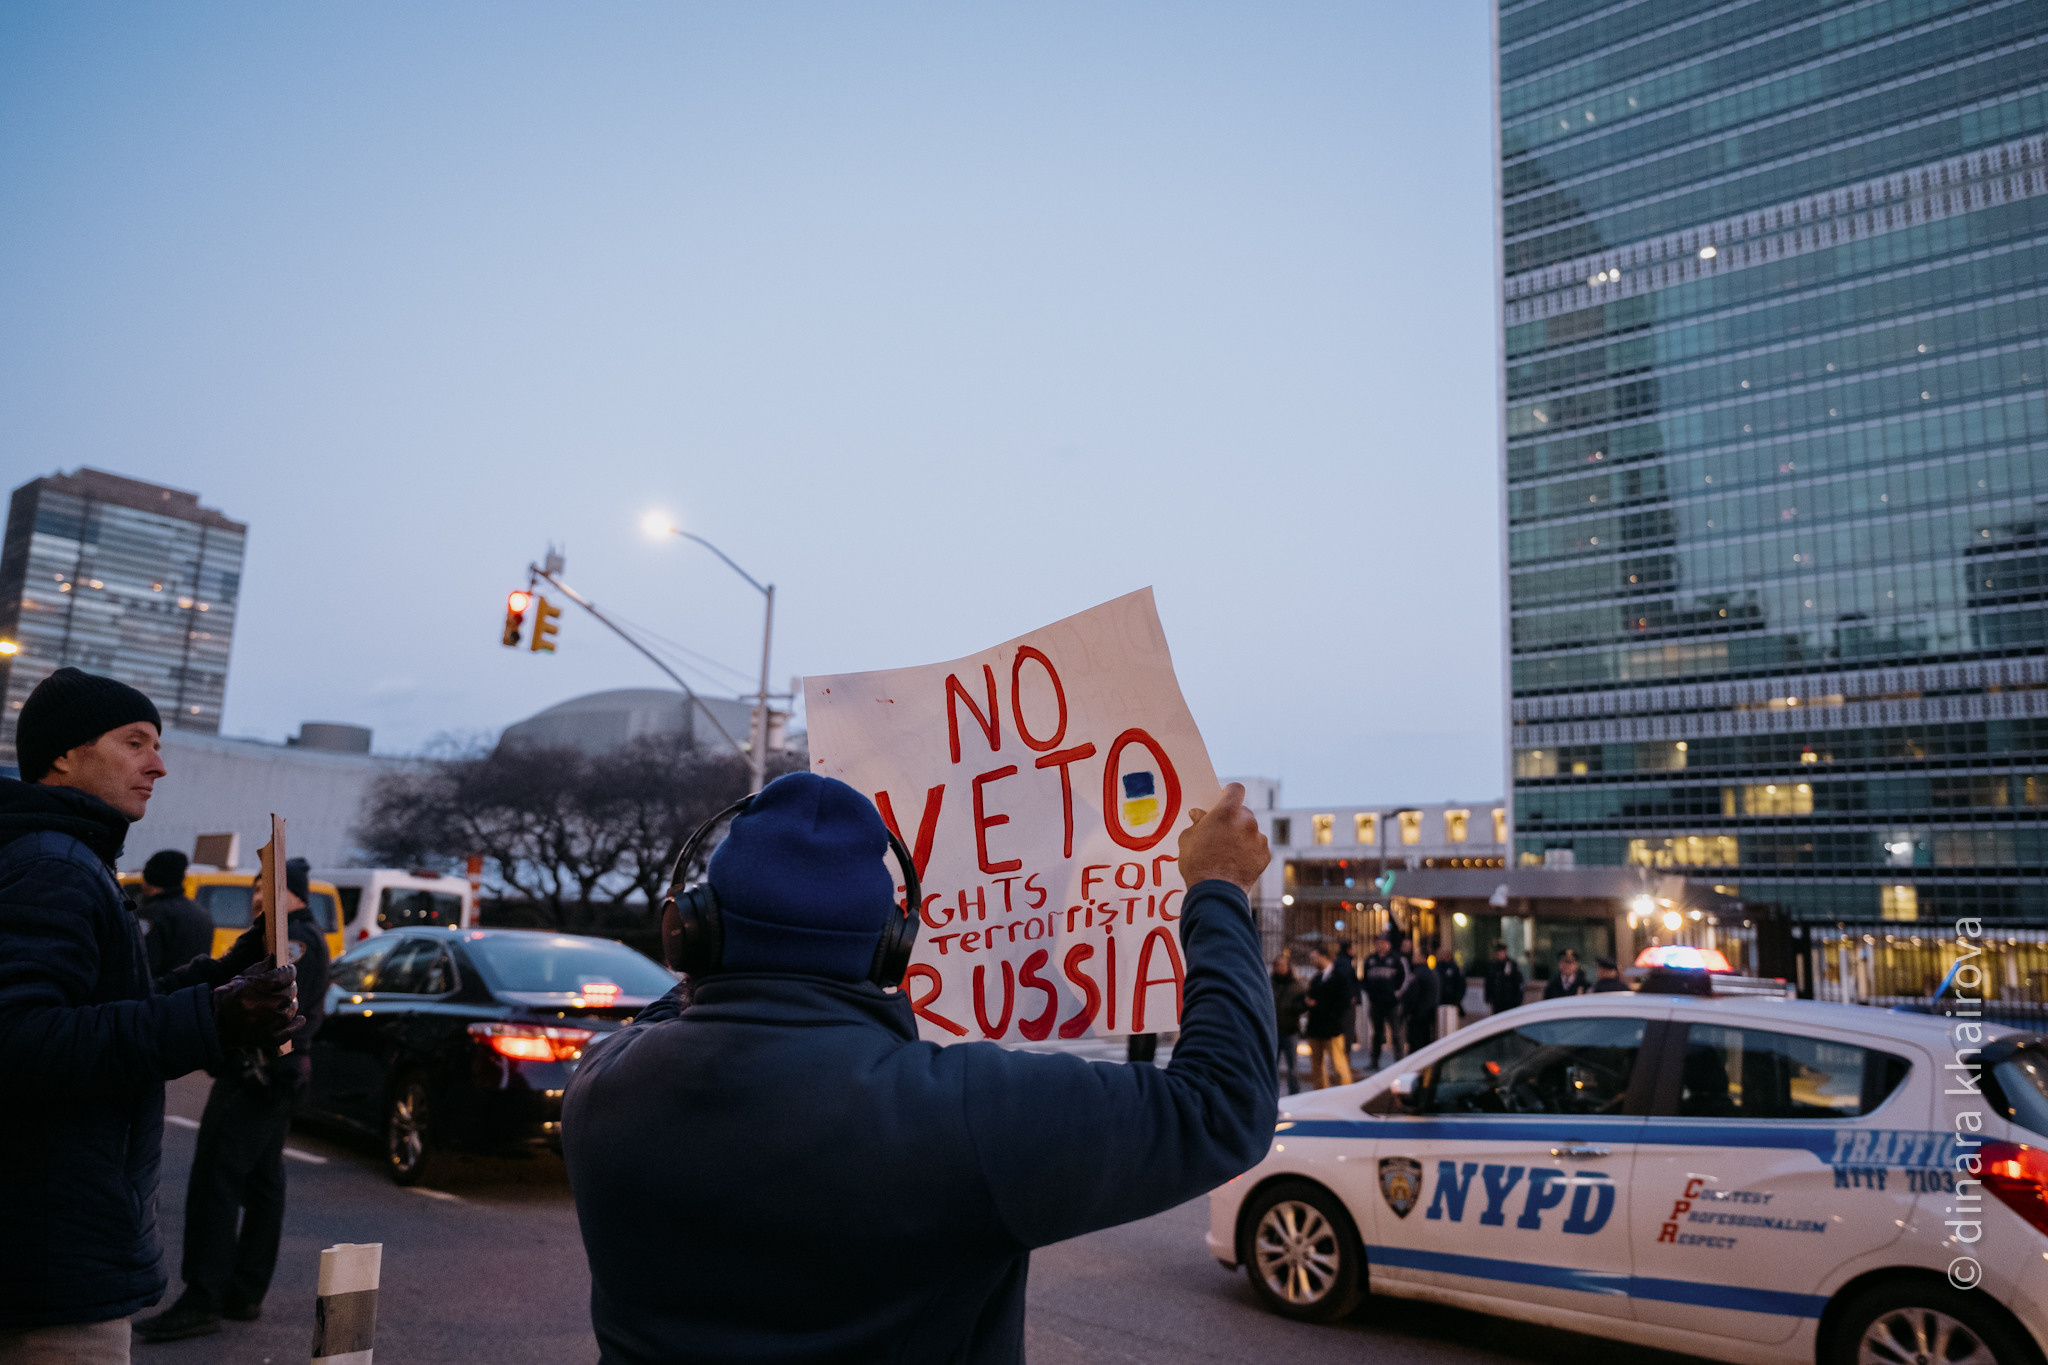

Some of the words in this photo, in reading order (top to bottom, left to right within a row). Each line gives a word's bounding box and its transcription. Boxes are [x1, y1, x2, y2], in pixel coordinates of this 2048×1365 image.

[945, 645, 1067, 764] NO
[875, 728, 1182, 883] VETO
[1832, 1130, 1958, 1167] TRAFFIC
[1425, 1161, 1616, 1235] NYPD
[1657, 1222, 1737, 1249] RESPECT
